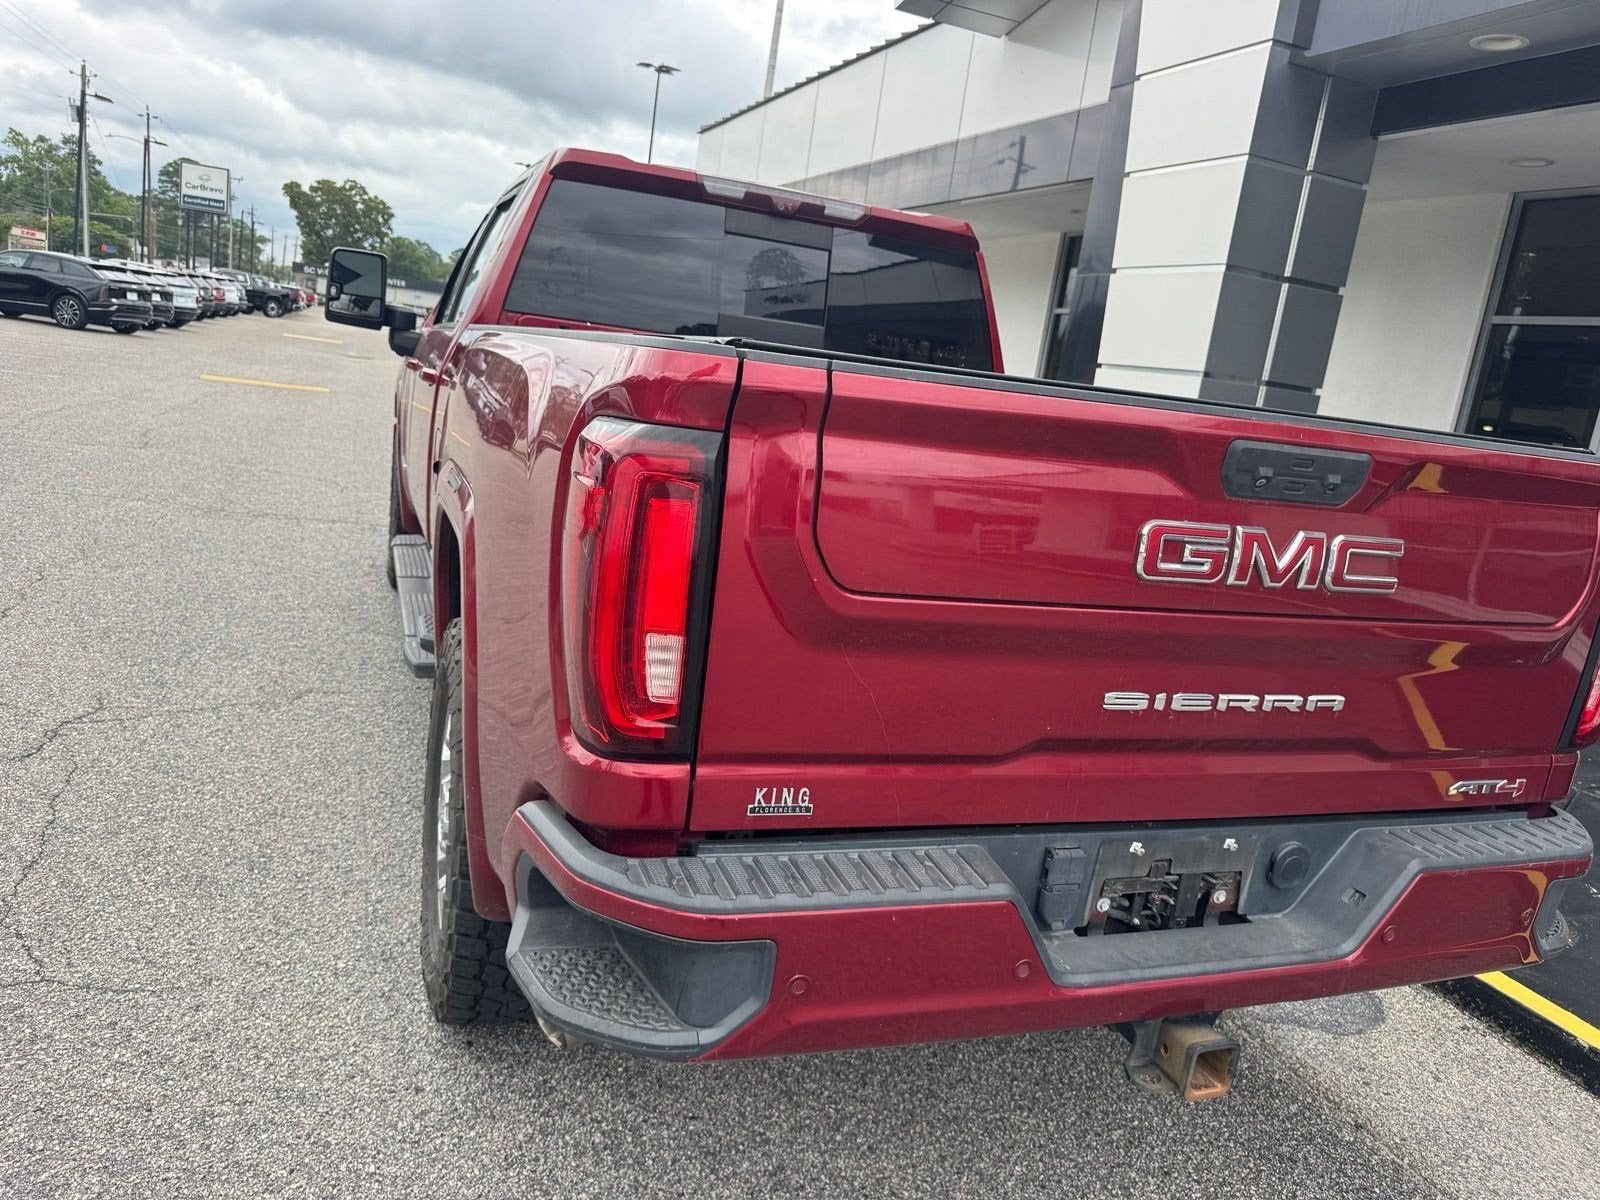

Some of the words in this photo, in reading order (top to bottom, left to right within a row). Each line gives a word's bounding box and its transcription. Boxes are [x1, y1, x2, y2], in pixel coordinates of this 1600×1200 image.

[185, 181, 224, 195] CarBravo
[1136, 519, 1405, 594] GMC
[1102, 691, 1346, 713] SIERRA
[755, 787, 810, 807] KING
[1447, 778, 1527, 799] AT4
